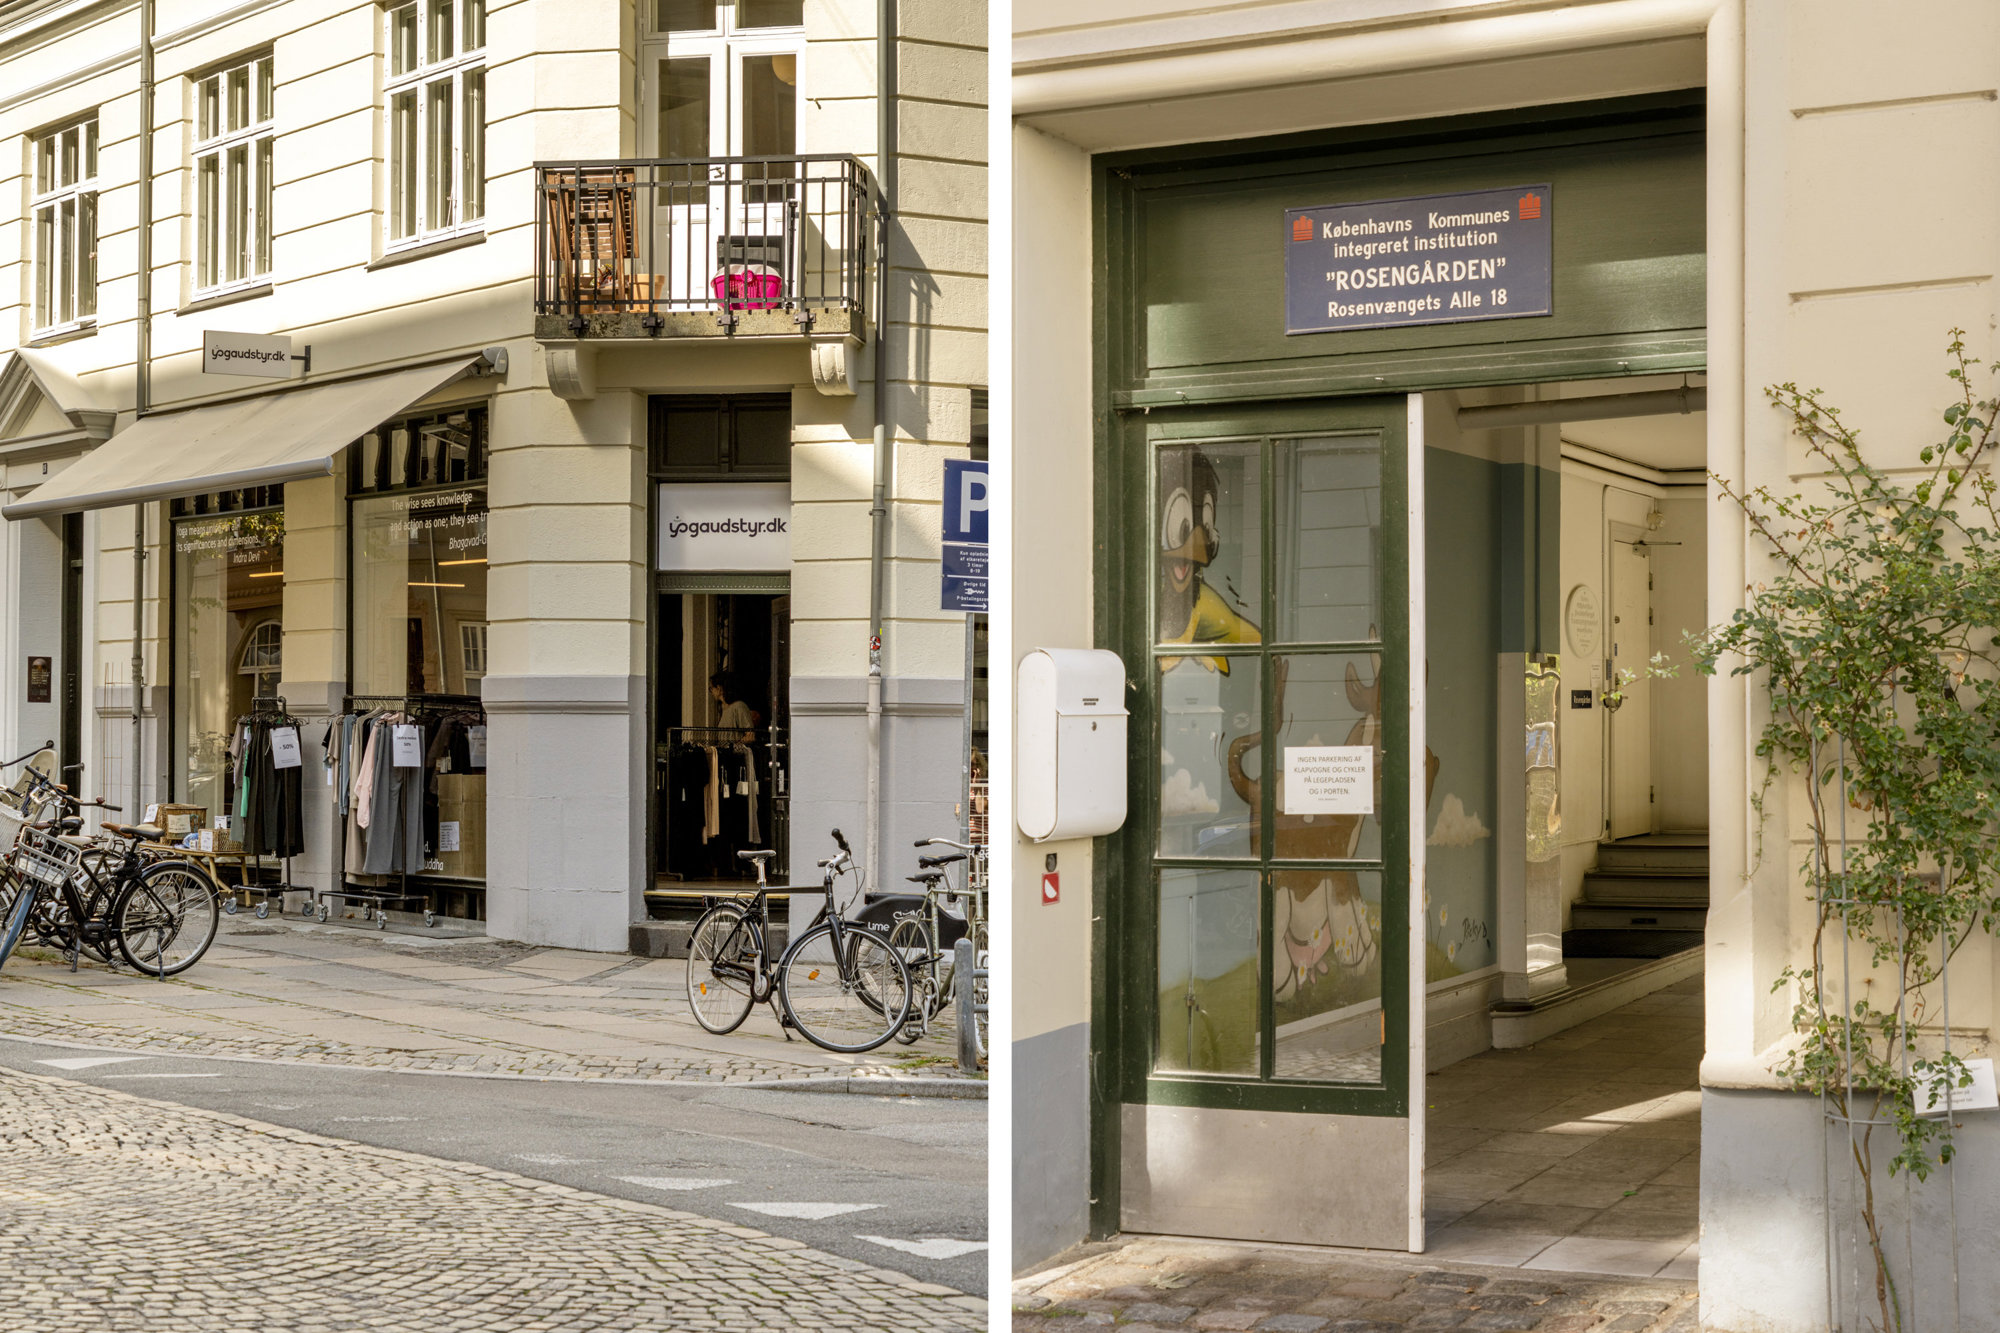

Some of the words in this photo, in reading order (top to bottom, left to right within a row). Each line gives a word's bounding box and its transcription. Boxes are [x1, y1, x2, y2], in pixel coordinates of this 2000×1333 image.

[1322, 218, 1413, 239] Københavns
[1428, 209, 1510, 229] Kommunes
[1334, 236, 1409, 260] integreret
[1414, 231, 1498, 251] institution
[1328, 294, 1441, 318] Rosenvængets
[1450, 291, 1481, 309] Alle
[1491, 288, 1508, 306] 18
[211, 346, 285, 363] yogaudstyr.dk
[392, 500, 403, 511] The
[405, 498, 419, 509] wise
[421, 498, 435, 508] sees
[436, 492, 473, 505] knowledge
[960, 470, 988, 533] P
[176, 526, 188, 538] Yoga
[189, 525, 206, 535] means
[390, 520, 401, 532] and
[404, 518, 423, 530] action
[425, 520, 432, 528] as
[450, 514, 465, 527] they
[467, 513, 479, 524] see
[669, 516, 787, 538] yogaudstyr.dk
[184, 539, 217, 553] significances
[218, 537, 227, 548] and
[233, 553, 247, 564] Indra
[248, 551, 261, 562] Devi
[867, 921, 890, 932] Lime
